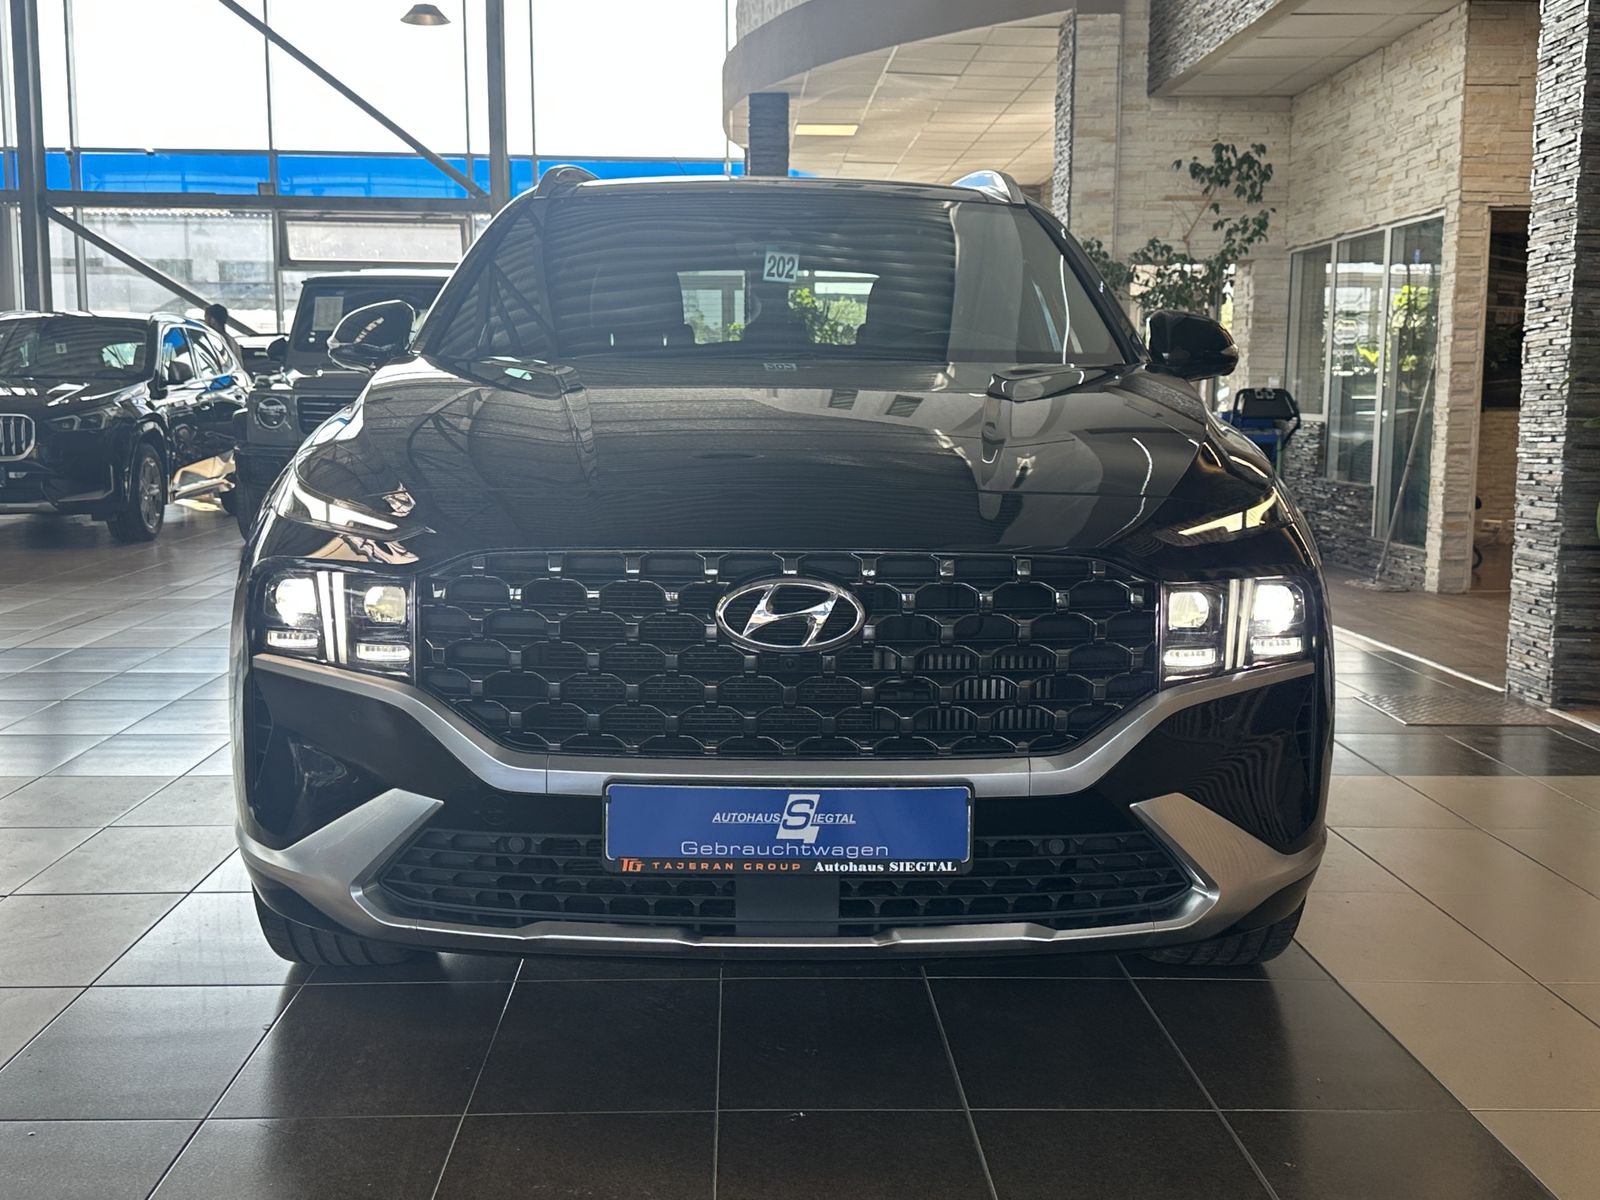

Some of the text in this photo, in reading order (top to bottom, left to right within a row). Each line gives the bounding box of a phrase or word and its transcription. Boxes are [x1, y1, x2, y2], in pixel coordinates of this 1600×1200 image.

[766, 255, 795, 279] 202
[712, 812, 781, 823] AUTOHAUS
[681, 841, 889, 859] Gebrauchtwagen
[652, 862, 734, 871] TAJERAN
[743, 863, 801, 871] GROUP
[814, 861, 884, 872] Autohaus
[889, 861, 957, 872] SIEGTAL
